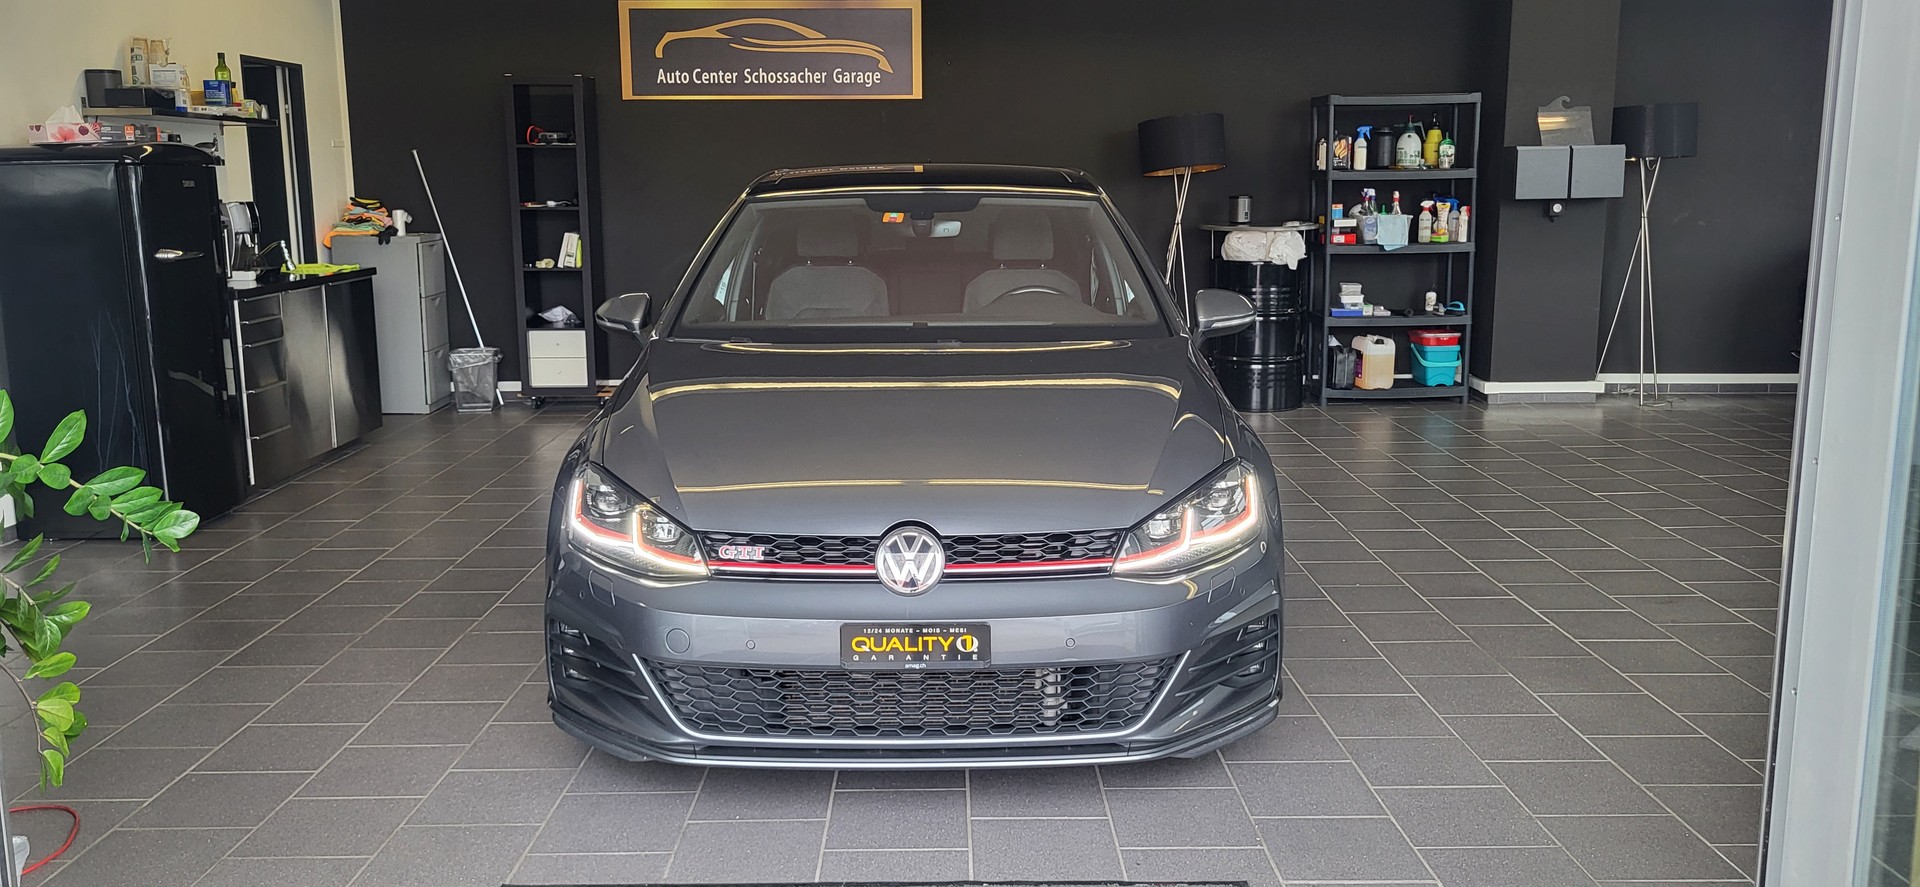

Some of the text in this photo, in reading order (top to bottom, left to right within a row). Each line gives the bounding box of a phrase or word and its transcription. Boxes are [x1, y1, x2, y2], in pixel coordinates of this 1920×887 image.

[657, 68, 881, 87] Auto Center Schossacher Garage
[718, 545, 766, 560] GTI
[851, 636, 954, 652] QUALITY
[905, 662, 927, 670] amag.ch
